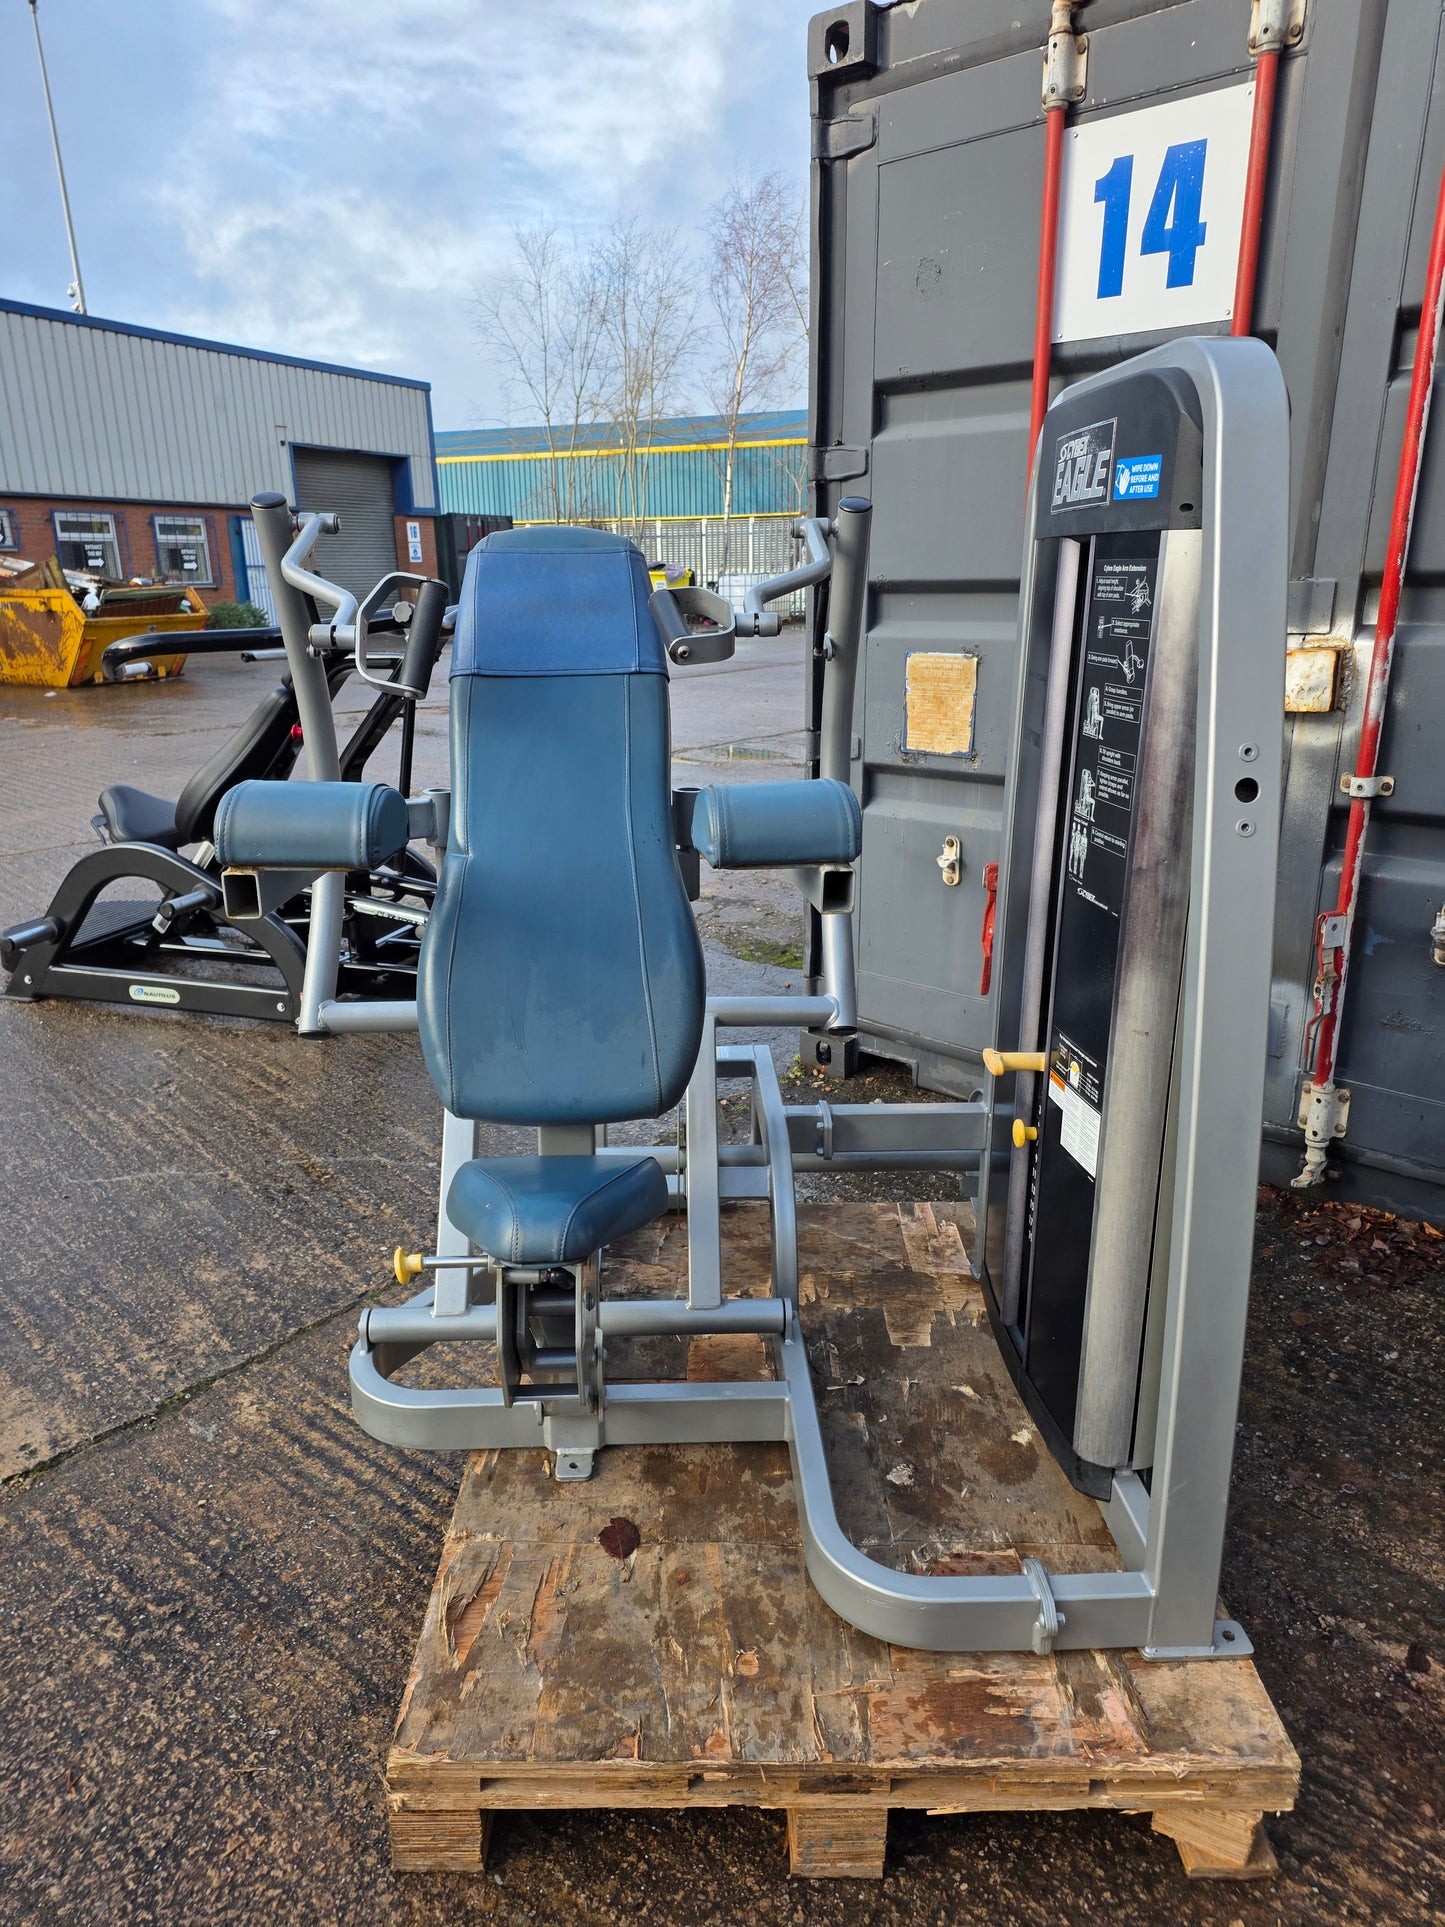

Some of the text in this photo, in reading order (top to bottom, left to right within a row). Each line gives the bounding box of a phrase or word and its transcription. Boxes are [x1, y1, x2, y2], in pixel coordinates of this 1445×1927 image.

[1094, 138, 1208, 299] 14
[1132, 462, 1158, 473] WIPE DOWN
[1052, 450, 1110, 504] EAGLE
[1130, 473, 1160, 483] BEFORE AND
[1129, 484, 1154, 494] AFTER USE
[410, 526, 418, 539] 16
[1113, 564, 1122, 573] Eagle
[144, 991, 176, 999] NAUTILUS
